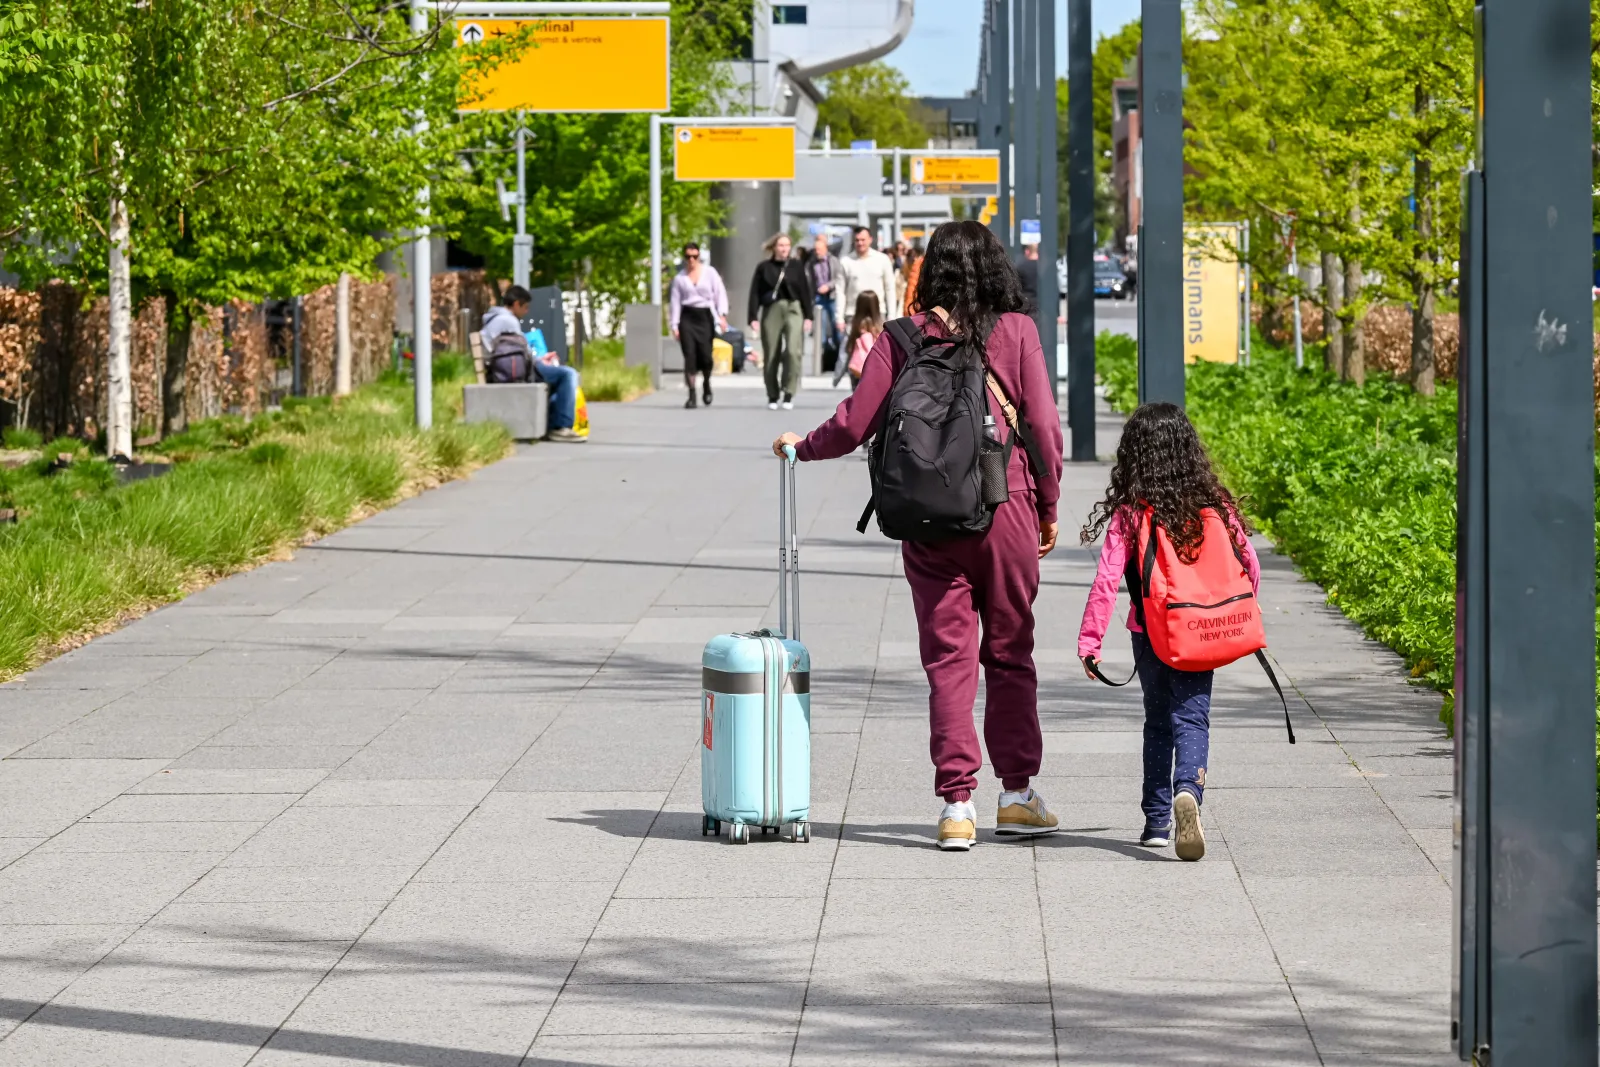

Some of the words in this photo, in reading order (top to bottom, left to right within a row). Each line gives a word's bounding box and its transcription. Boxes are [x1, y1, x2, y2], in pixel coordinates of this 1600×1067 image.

[514, 20, 575, 33] Teminal
[571, 35, 602, 44] vertrek
[1187, 616, 1226, 631] CALVIN
[1227, 611, 1252, 625] KLEIN
[1199, 631, 1221, 642] NEW
[1222, 627, 1244, 638] YORK
